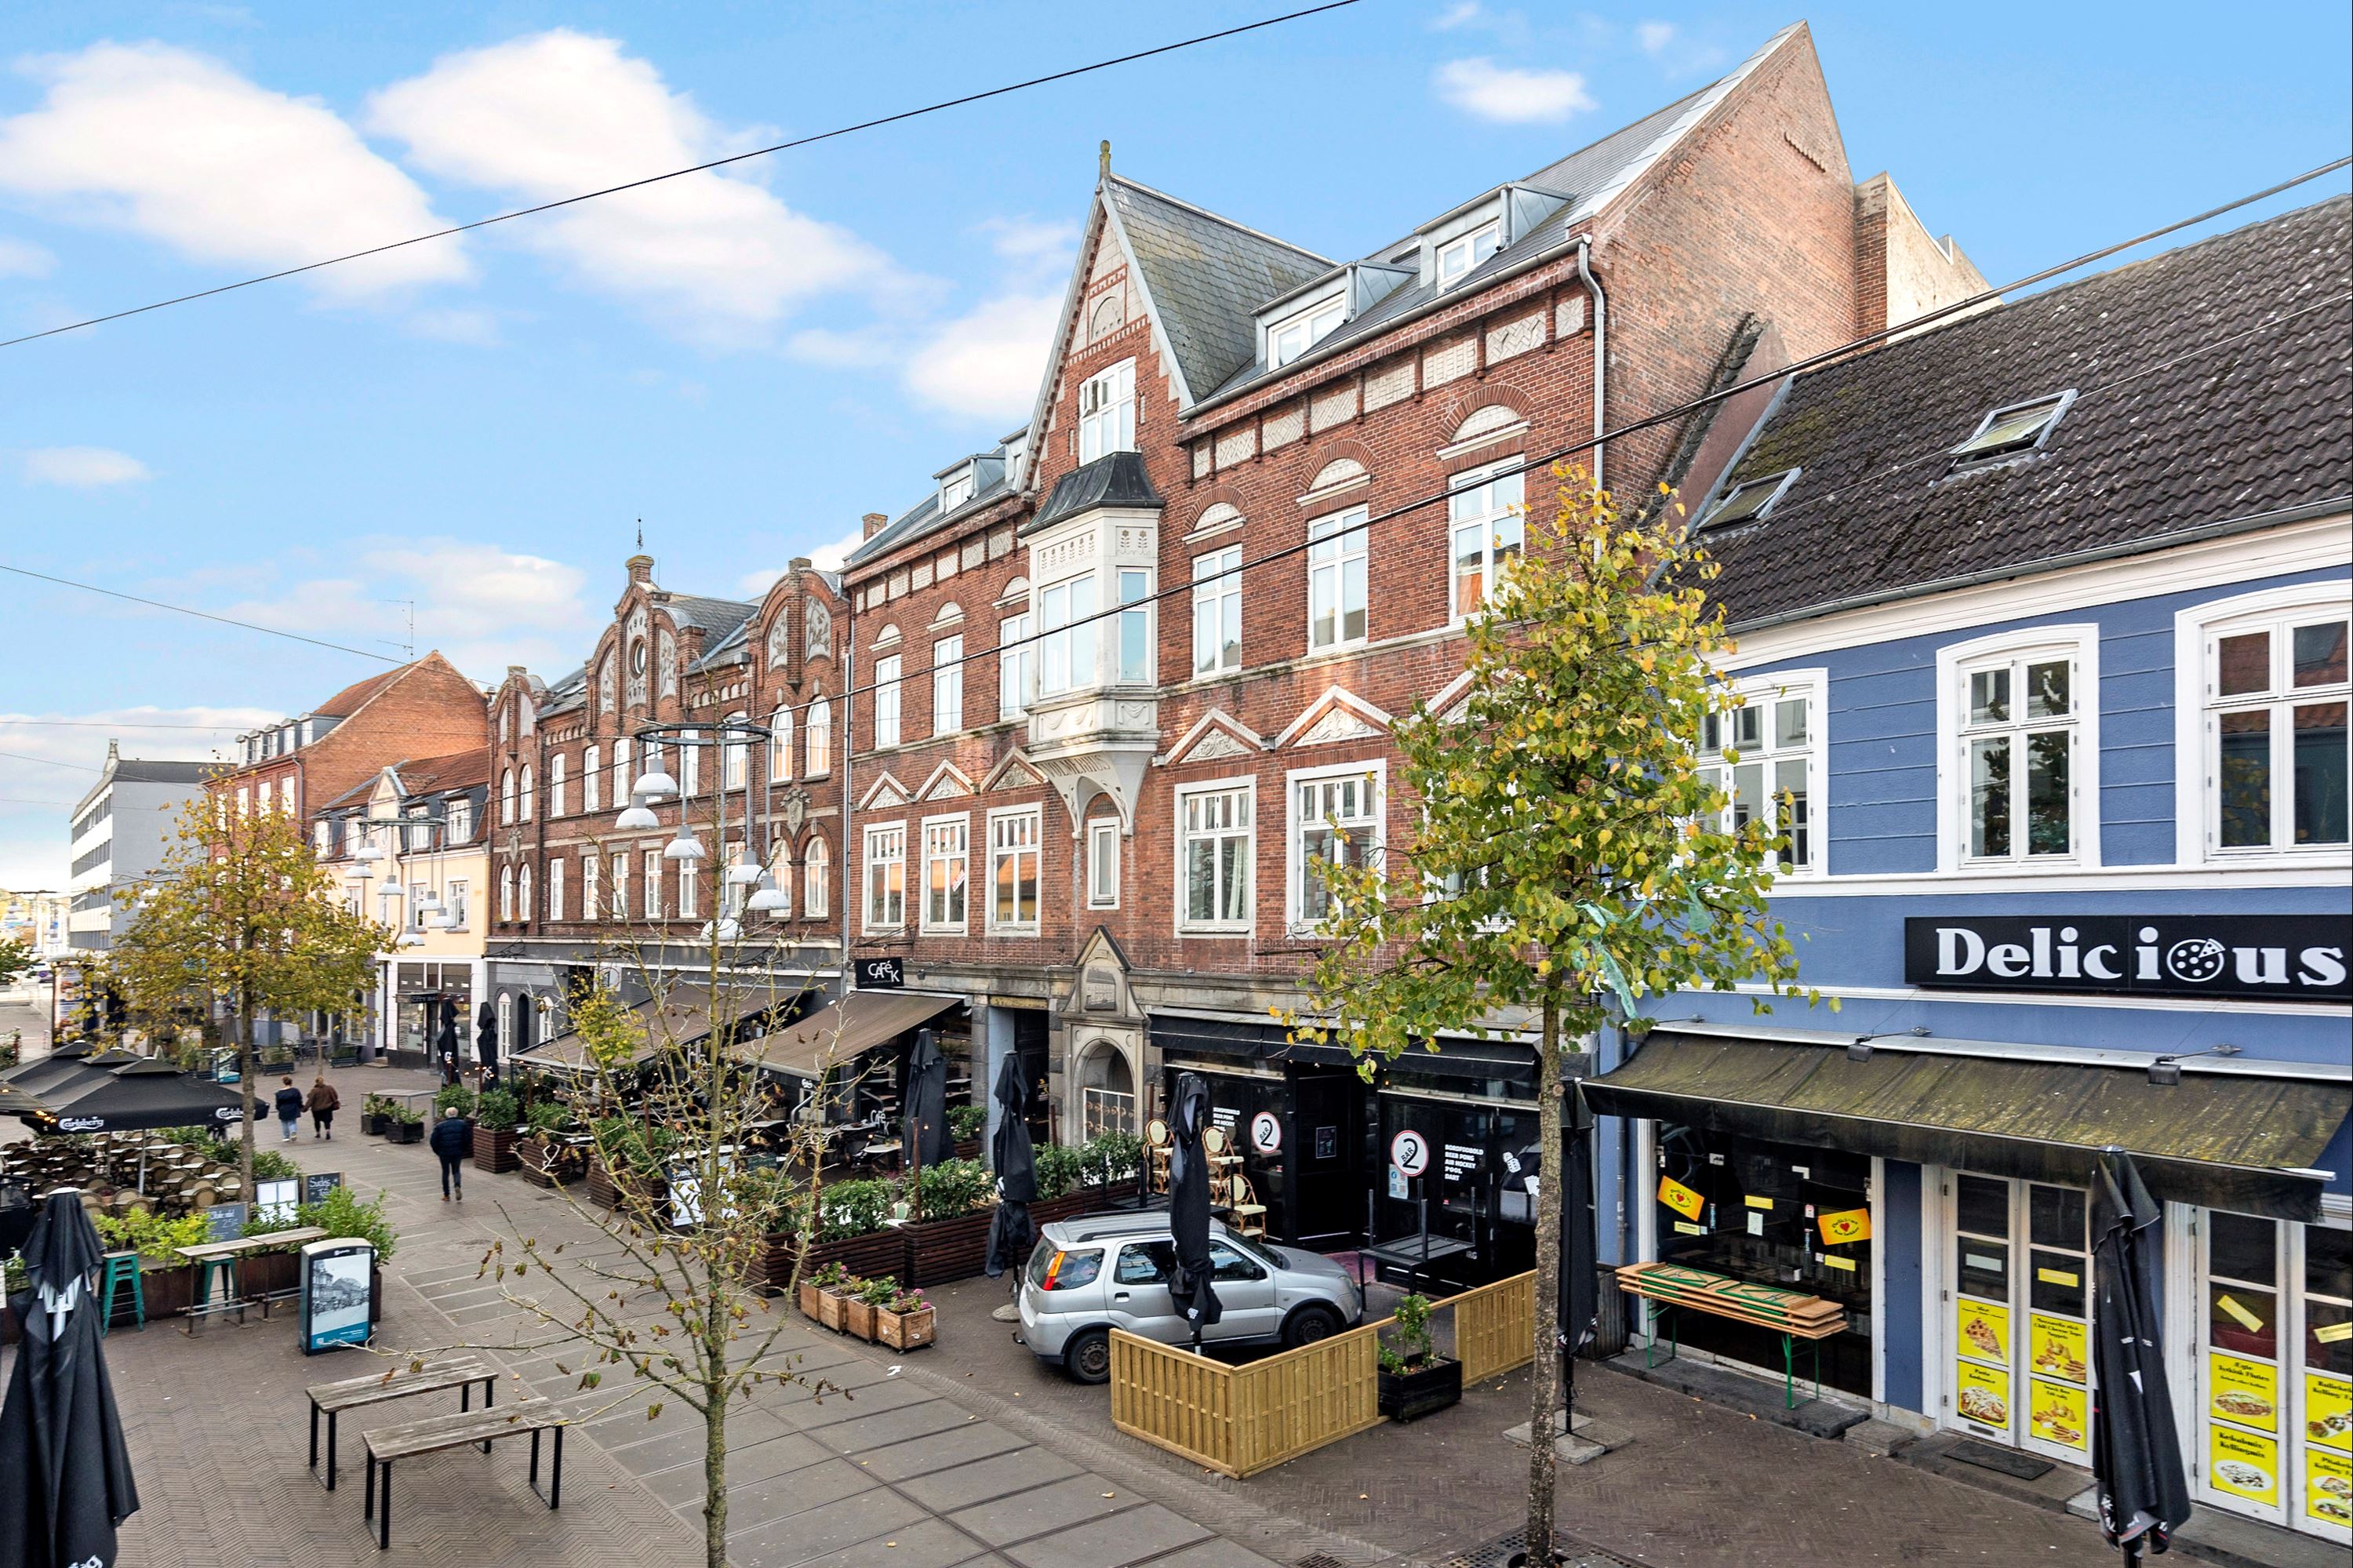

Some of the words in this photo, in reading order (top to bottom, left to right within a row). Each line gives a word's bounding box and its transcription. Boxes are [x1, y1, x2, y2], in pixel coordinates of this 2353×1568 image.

[1936, 926, 2348, 987] Delicious
[215, 1107, 244, 1119] Carlsb
[59, 1116, 104, 1131] Carlsberg
[1259, 1126, 1269, 1141] BAR
[1260, 1119, 1274, 1147] 2
[1401, 1147, 1414, 1162] BAR
[1402, 1137, 1420, 1170] 2
[1459, 1153, 1475, 1162] PONG
[1455, 1160, 1476, 1169] HOCKEY
